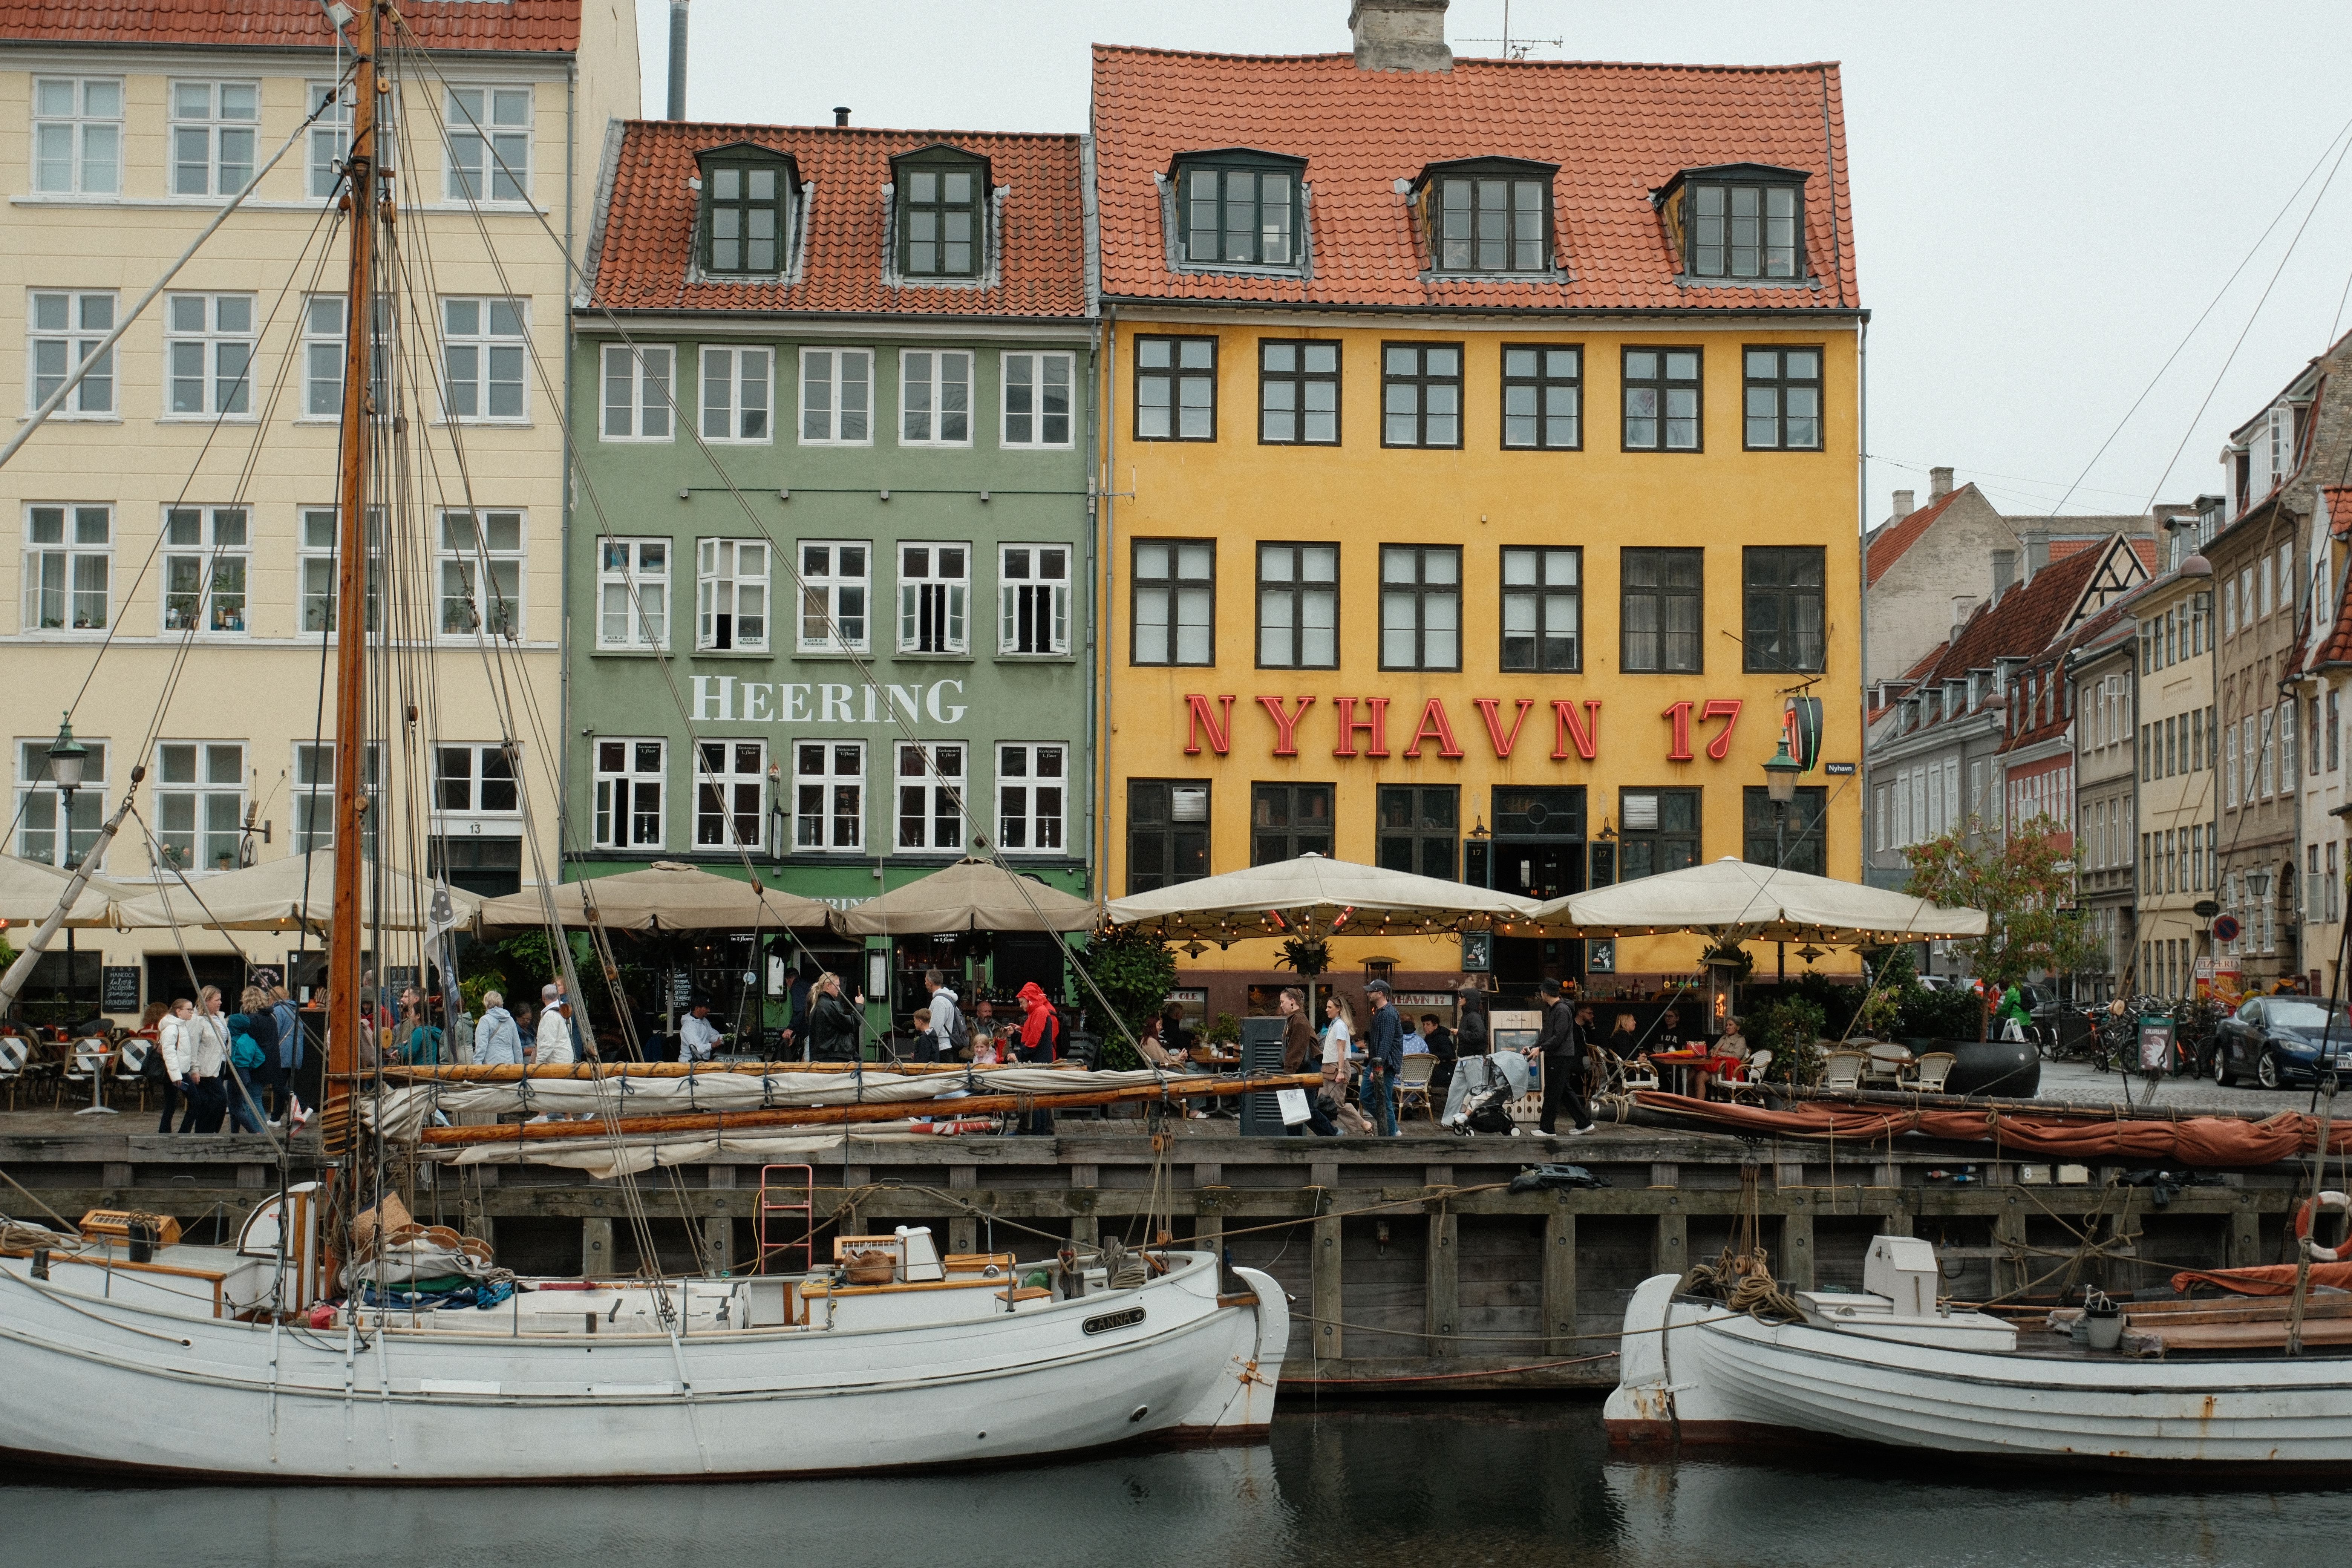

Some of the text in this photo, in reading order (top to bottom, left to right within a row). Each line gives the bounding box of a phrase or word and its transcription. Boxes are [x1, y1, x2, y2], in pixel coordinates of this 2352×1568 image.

[689, 675, 968, 724] HEERING
[1184, 694, 1602, 759] NYHAVN
[1661, 699, 1744, 761] 17
[470, 824, 481, 834] 13
[1435, 996, 1445, 1004] 17
[2024, 1167, 2032, 1179] 8
[1098, 1313, 1132, 1330] ANNA
